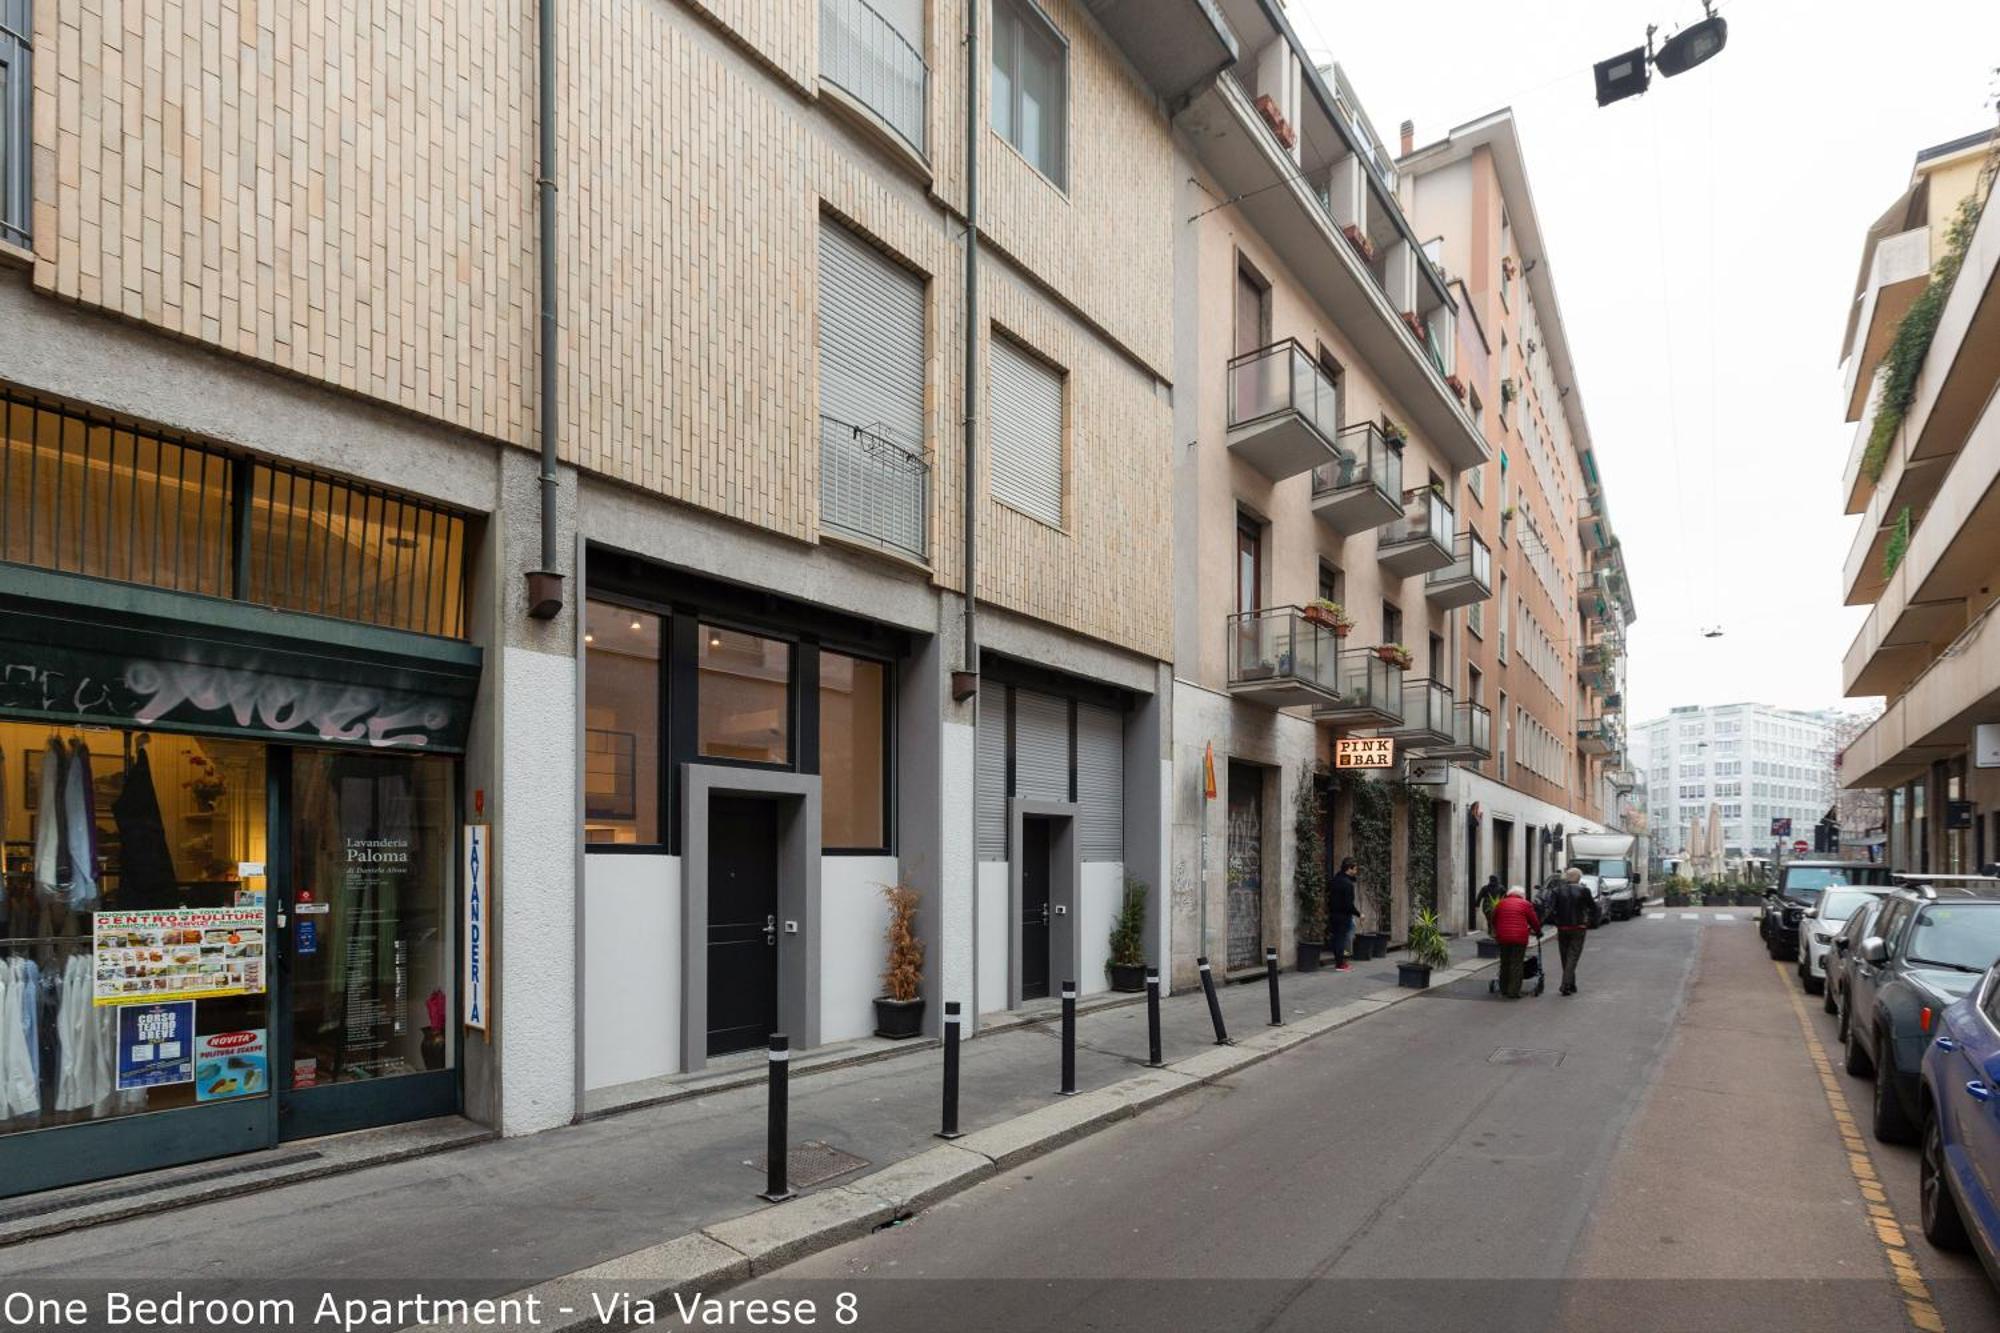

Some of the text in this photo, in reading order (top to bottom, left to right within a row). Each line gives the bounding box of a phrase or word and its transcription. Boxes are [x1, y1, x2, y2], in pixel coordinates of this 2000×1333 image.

[1340, 740, 1390, 752] PINK
[1353, 754, 1389, 766] BAR
[346, 837, 408, 848] Lavanderia
[346, 848, 408, 862] Paloma
[97, 912, 264, 925] CENTRO PULITURE
[470, 826, 480, 1023] LAVANDERIA
[138, 1012, 177, 1024] CORSO
[137, 1020, 177, 1032] TEATRO
[138, 1029, 175, 1041] BREVE
